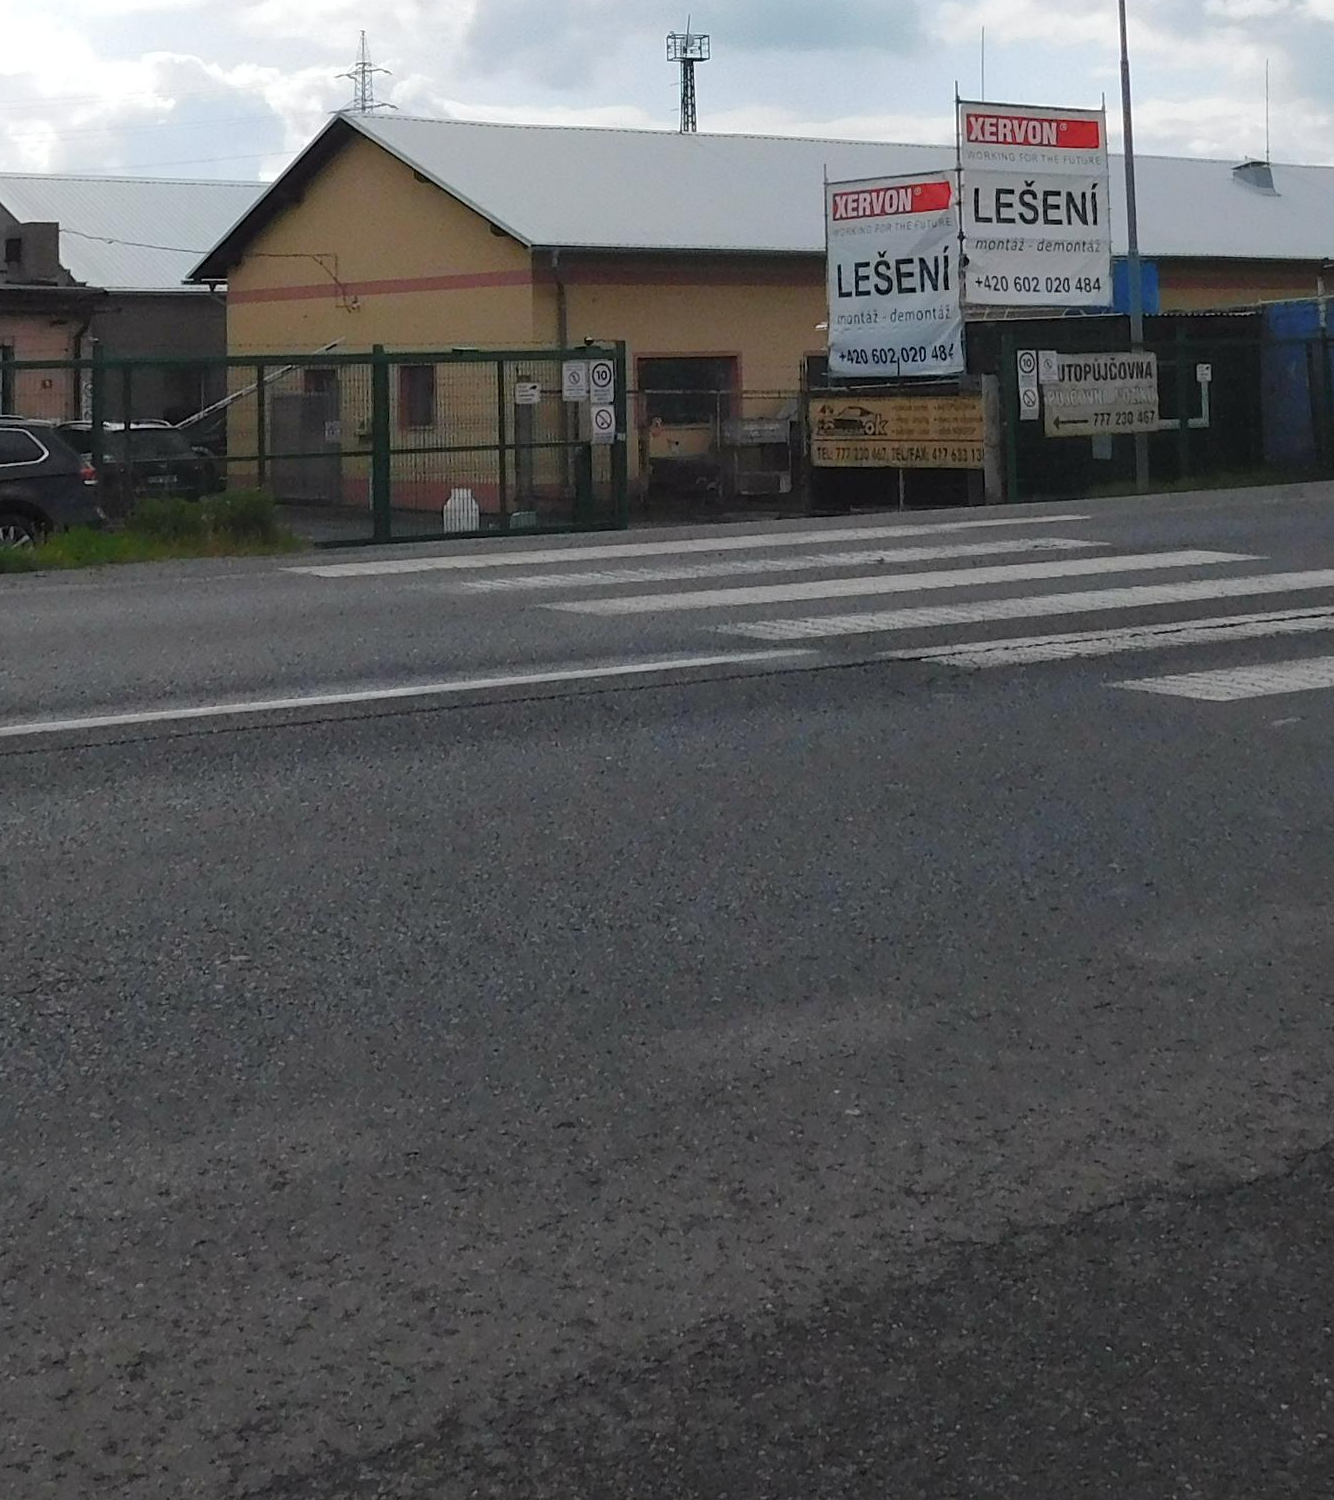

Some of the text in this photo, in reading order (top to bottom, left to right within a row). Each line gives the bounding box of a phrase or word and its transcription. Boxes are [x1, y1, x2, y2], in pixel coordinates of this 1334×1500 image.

[968, 151, 1101, 166] WORKING FOR THE FUTURE
[974, 180, 1098, 226] LEŠENÍ
[874, 223, 892, 233] FOR
[895, 221, 912, 231] THE
[915, 217, 953, 229] FUTURE
[975, 238, 1025, 252] montáž
[1036, 238, 1101, 253] demontáž
[837, 245, 950, 298] LEŠENÍ
[975, 275, 1101, 293] +420 602 020 484
[837, 309, 879, 325] montáž
[890, 304, 950, 323] demontáž
[839, 348, 869, 364] +420
[871, 347, 896, 365] 602
[900, 346, 927, 363] 020
[1022, 358, 1032, 368] 10
[596, 370, 608, 381] 10
[1057, 357, 1153, 382] UTOPŮJČOVNA
[1093, 410, 1156, 426] 777 230 467
